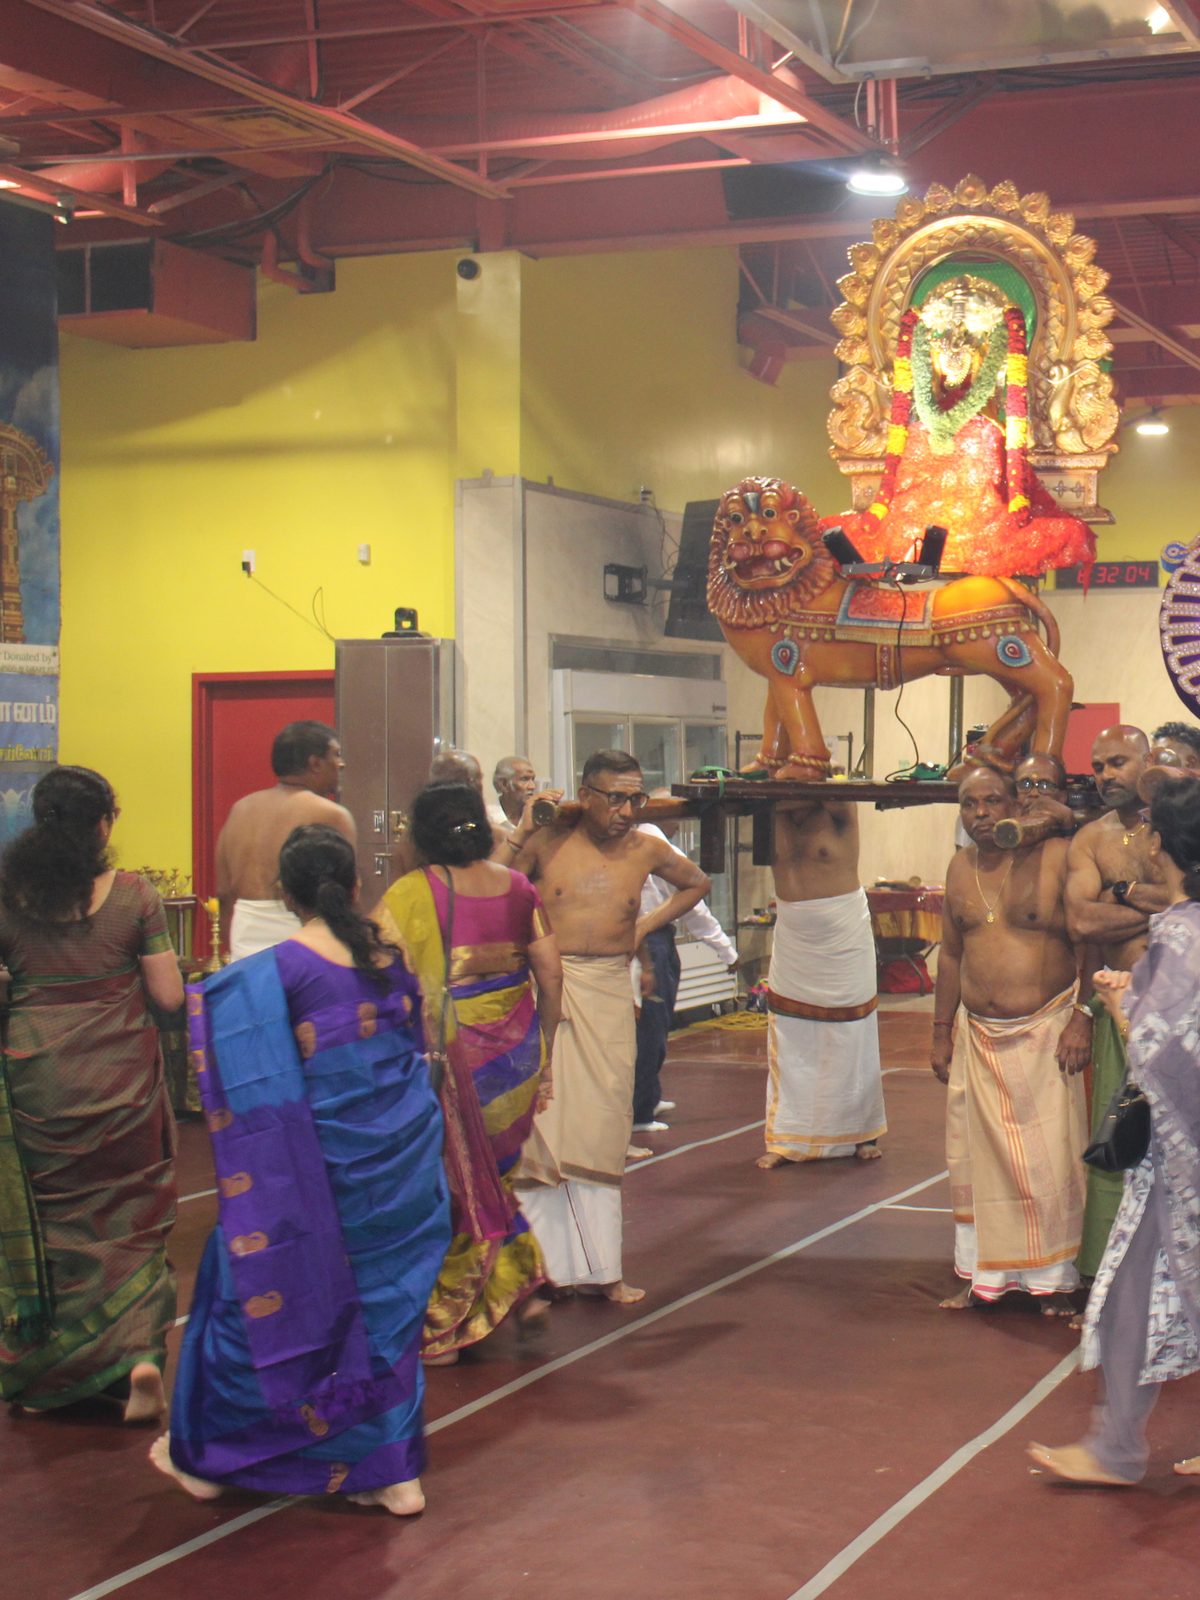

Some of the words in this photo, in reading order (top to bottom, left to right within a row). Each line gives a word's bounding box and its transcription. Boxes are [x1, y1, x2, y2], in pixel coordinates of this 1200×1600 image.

[1095, 565, 1120, 584] 32
[1125, 565, 1150, 583] 04
[3, 651, 40, 662] Donated
[42, 653, 52, 665] by
